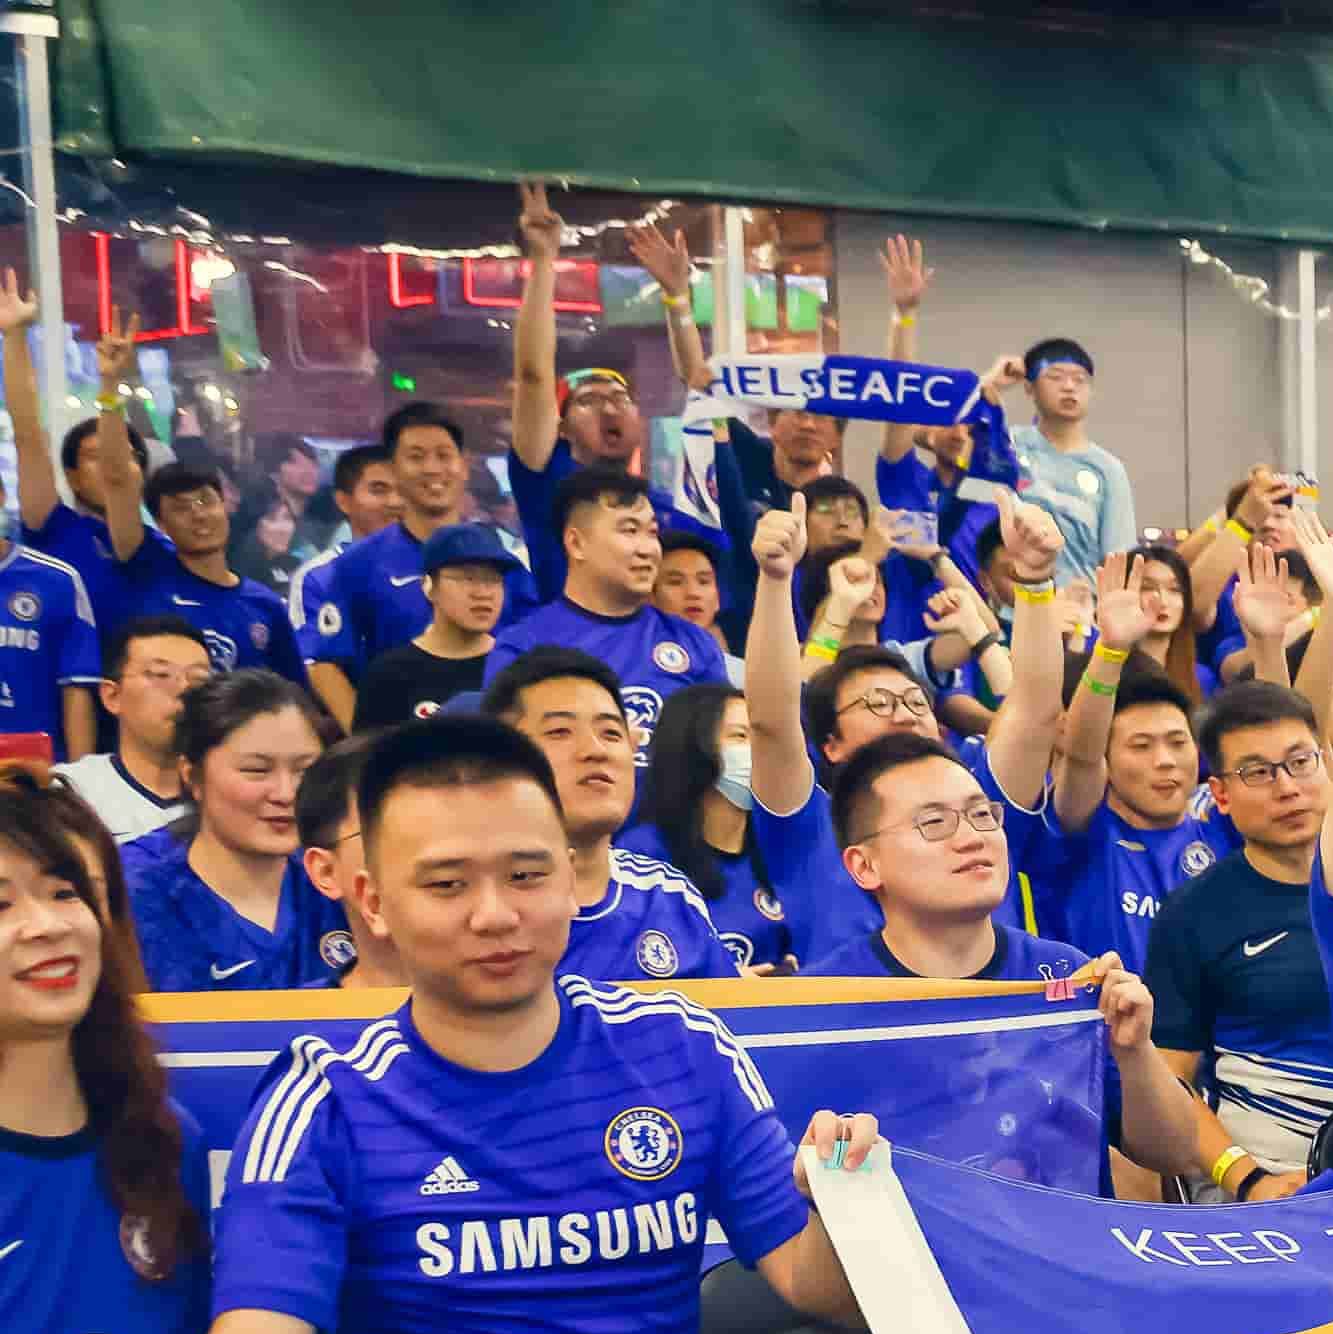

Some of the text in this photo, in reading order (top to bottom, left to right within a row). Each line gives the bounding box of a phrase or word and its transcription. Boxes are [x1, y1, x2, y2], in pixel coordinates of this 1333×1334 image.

[704, 364, 955, 407] HELSEAFC
[420, 1180, 480, 1195] adidas
[416, 1192, 698, 1278] SAMSUNG
[1111, 1226, 1302, 1267] KEEP
